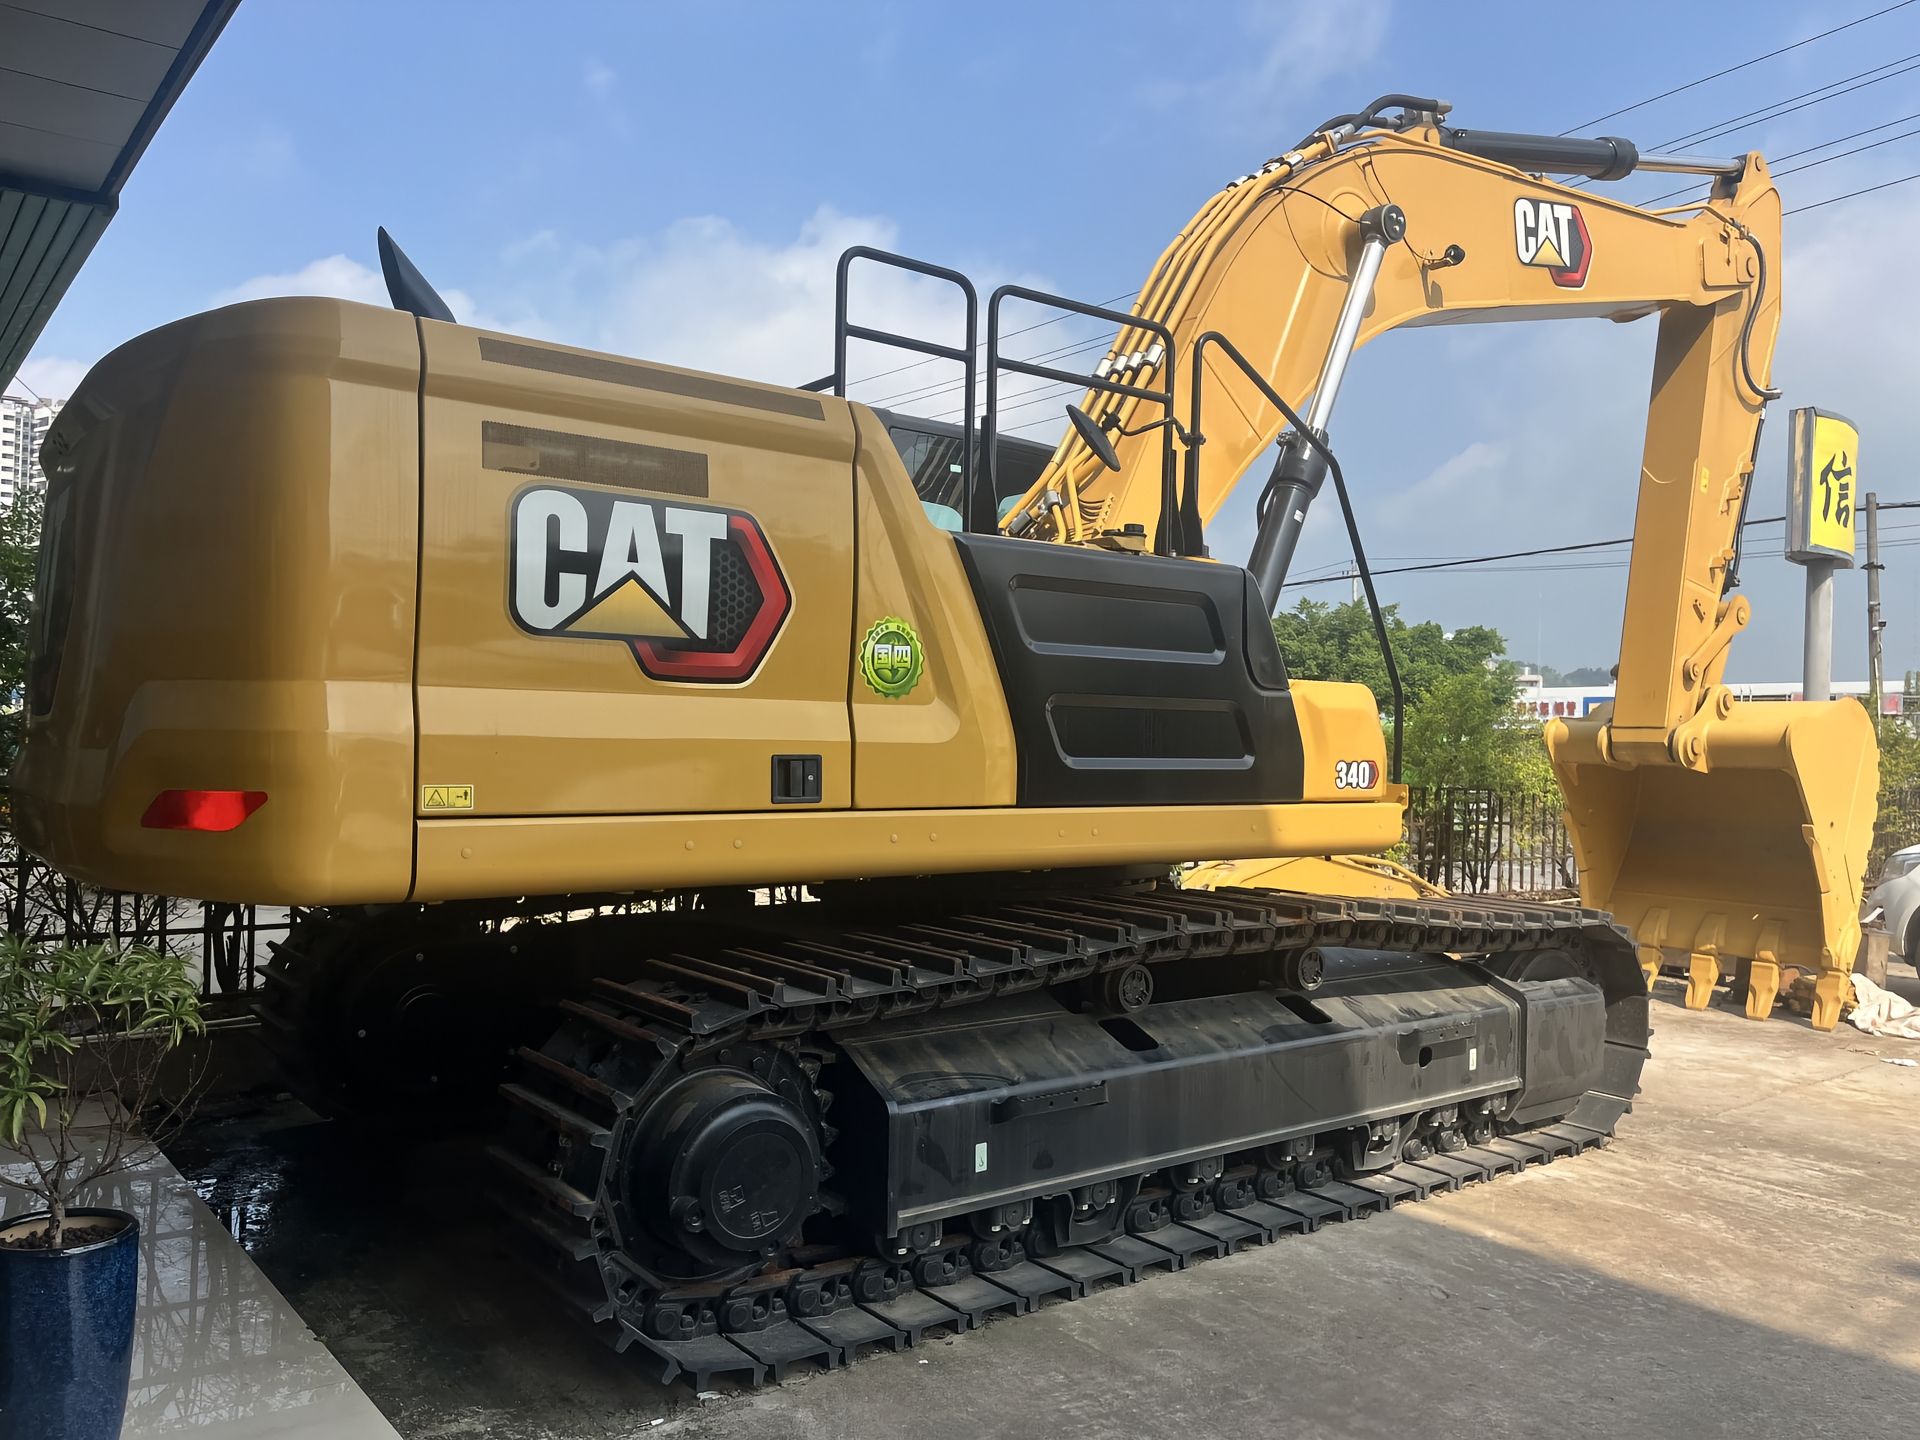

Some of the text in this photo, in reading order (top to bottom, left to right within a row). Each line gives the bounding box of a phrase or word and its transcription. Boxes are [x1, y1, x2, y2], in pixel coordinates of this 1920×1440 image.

[1514, 198, 1573, 268] CAT
[1820, 450, 1852, 528] 信
[515, 489, 728, 640] CAT
[874, 644, 911, 669] 国四
[1335, 760, 1370, 789] 340
